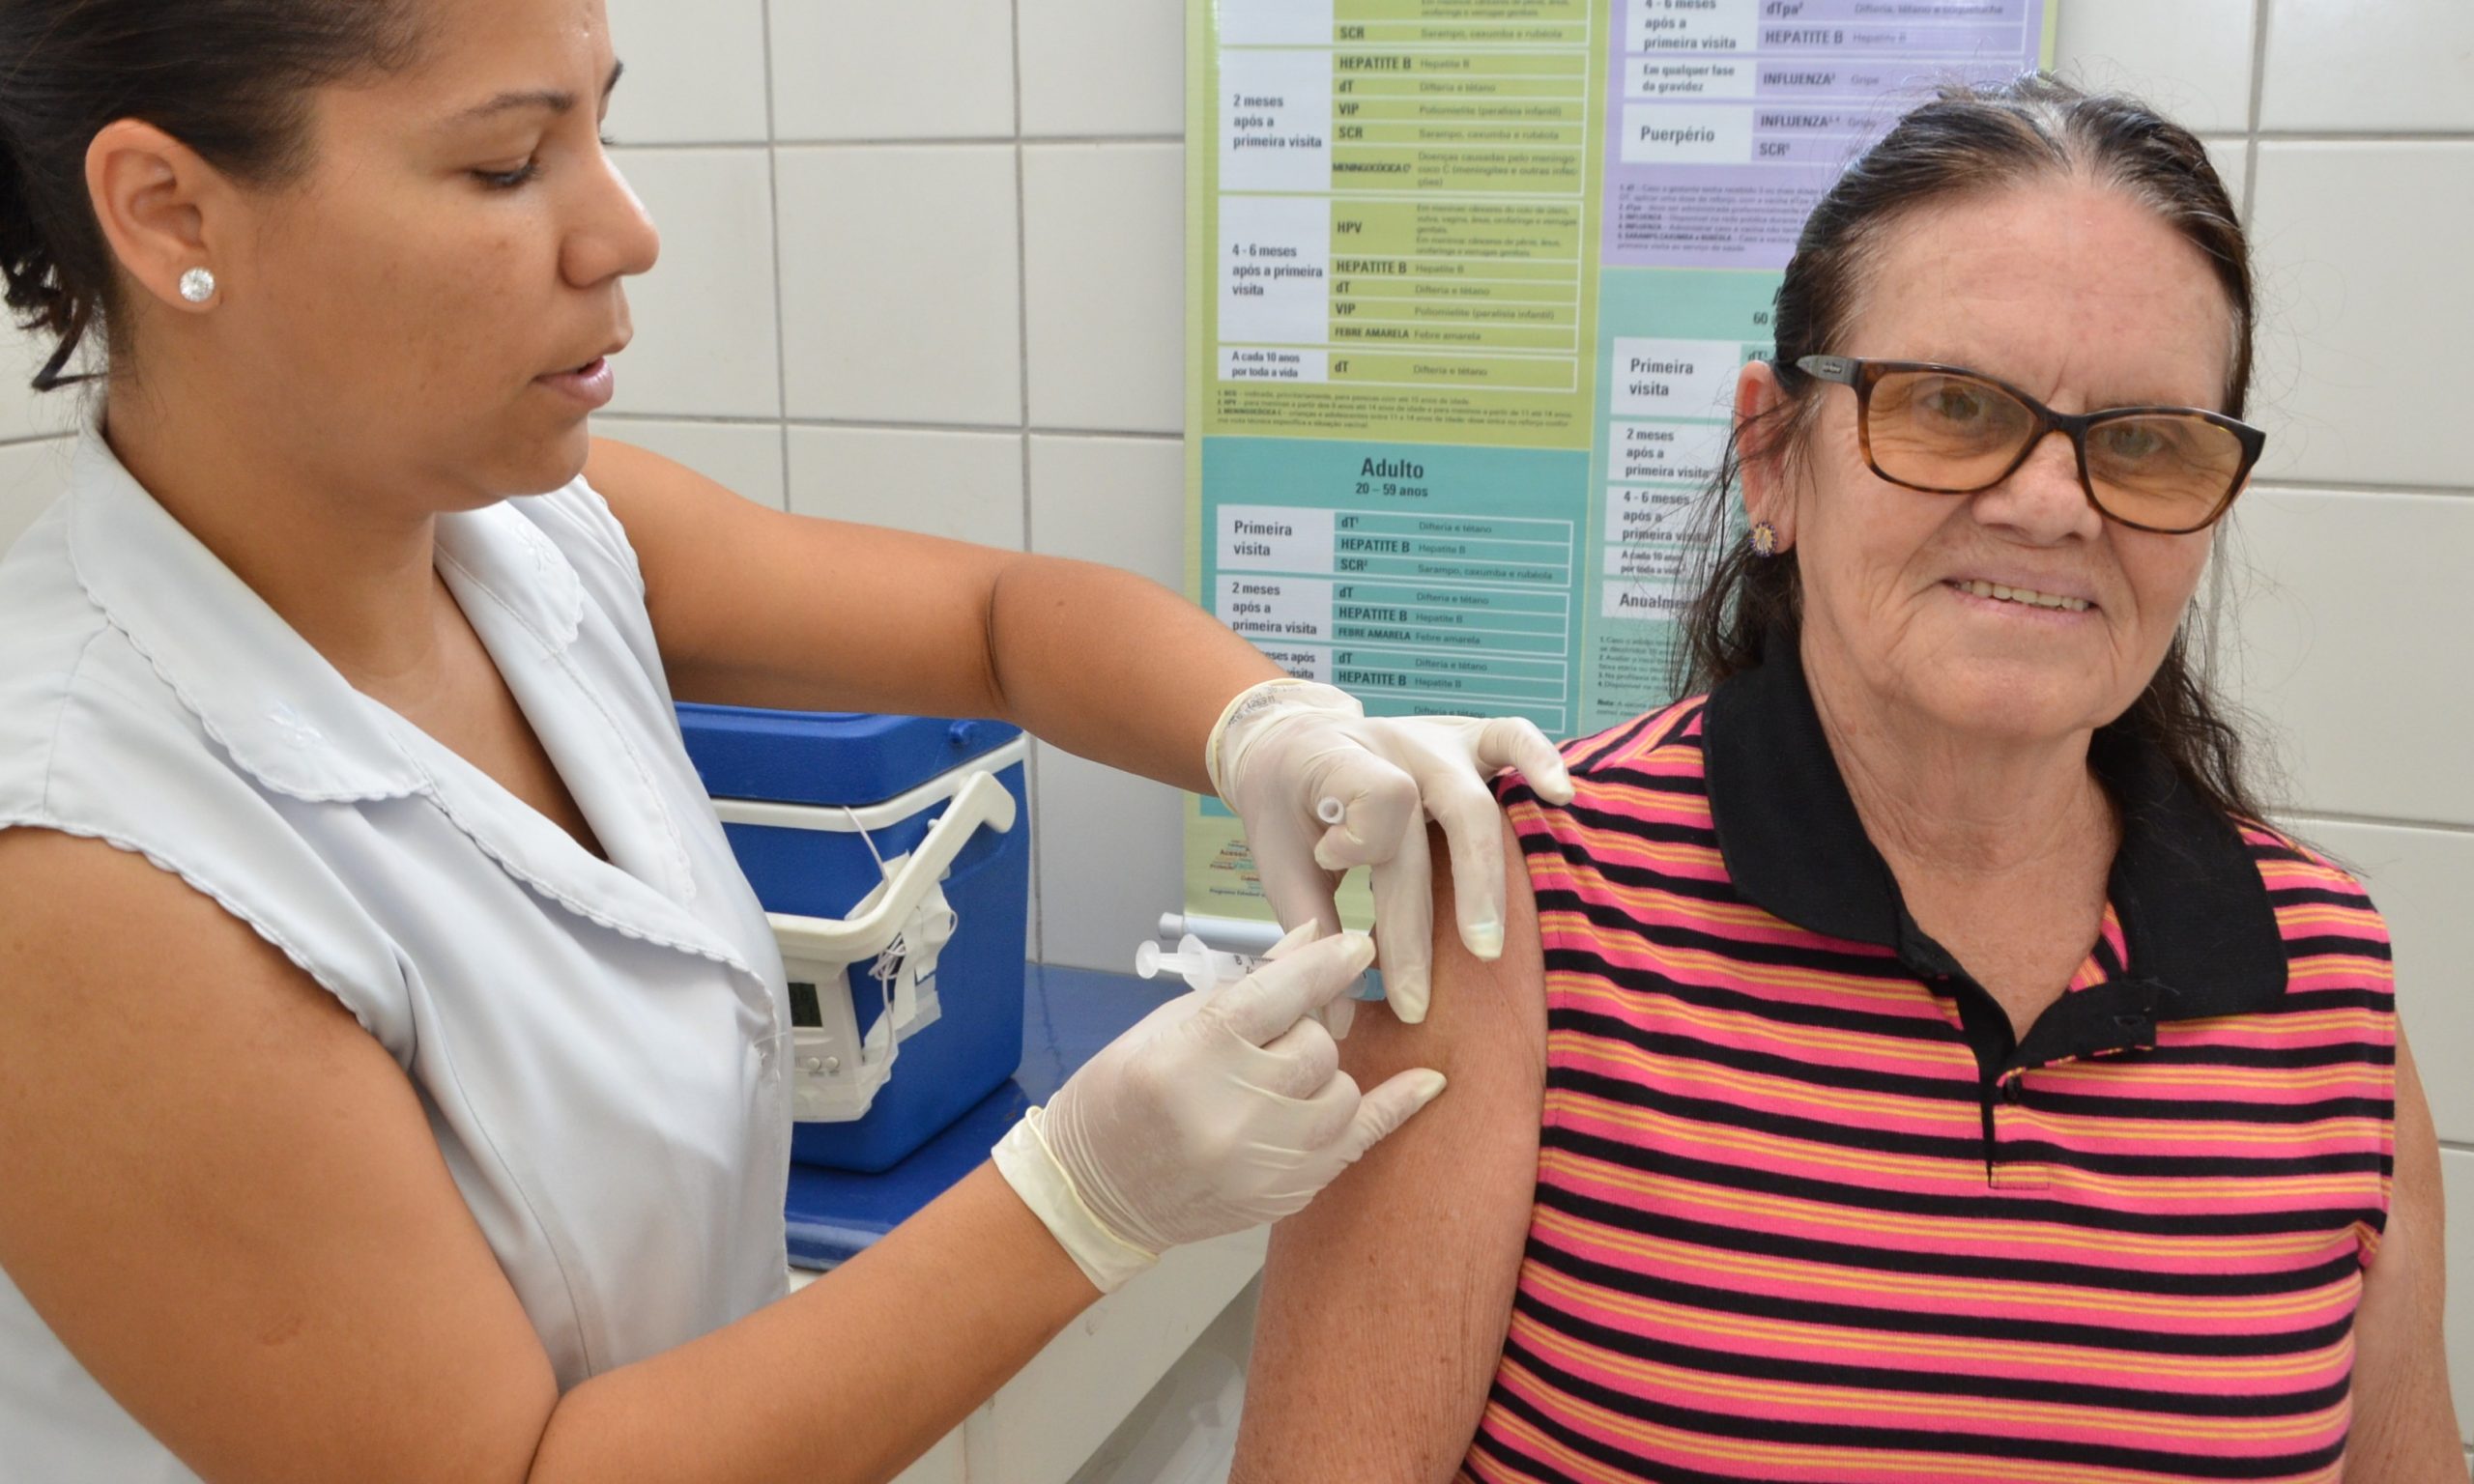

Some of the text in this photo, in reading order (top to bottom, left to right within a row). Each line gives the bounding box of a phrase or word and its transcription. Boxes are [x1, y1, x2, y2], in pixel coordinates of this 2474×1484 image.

[1644, 0, 1653, 9] 4
[1664, 0, 1672, 9] 6
[1675, 0, 1716, 9] meses
[1645, 17, 1686, 31] após a
[1339, 26, 1366, 40] SCR
[1765, 30, 1907, 44] HEPATITE B Hepatite B
[1644, 36, 1737, 52] primeira visita
[1339, 57, 1470, 70] HEPATITE B Hepatite B
[1643, 64, 1735, 77] Em qualquer fase
[1338, 79, 1354, 93] dT
[1851, 73, 1880, 86] Gripe
[1642, 81, 1703, 94] da gravidez
[1233, 94, 1284, 107] 2 meses
[1338, 102, 1360, 116] VIP
[1233, 114, 1275, 131] após a
[1338, 127, 1364, 139] SCR
[1640, 125, 1715, 145] Puerpério
[1233, 134, 1323, 150] primeira visita
[1338, 221, 1363, 234] HPV
[1231, 243, 1240, 256] 4
[1249, 243, 1257, 257] 6
[1258, 245, 1298, 258] meses
[1232, 264, 1323, 280] após a primeira
[1337, 261, 1464, 274] HEPATITE B Hepatite B
[1231, 282, 1265, 297] visita
[1336, 281, 1351, 294] dT
[1415, 284, 1450, 295] Difteria
[1460, 286, 1490, 296] tétano
[1336, 302, 1555, 321] VIP Poliomielite (paralisia infantil)
[1753, 311, 1769, 325] 60
[1335, 328, 1482, 341] FEBRE AMARELA Febre amarela
[1231, 351, 1300, 363] A cada 10 anos
[1231, 366, 1299, 379] por toda a vida
[1335, 360, 1349, 374] dT
[1413, 364, 1448, 375] Difteria
[1457, 366, 1488, 376] tétano
[1630, 357, 1694, 375] Primeira
[1628, 381, 1670, 397] visita
[1626, 428, 1675, 442] 2 meses
[1625, 446, 1664, 461] após a
[1361, 457, 1424, 479] Adulto
[1625, 466, 1675, 478] primeira
[1355, 482, 1369, 495] 20
[1383, 483, 1396, 496] 59
[1399, 485, 1428, 498] anos
[1624, 491, 1631, 503] 4
[1641, 491, 1650, 503] 6
[1652, 493, 1690, 505] meses
[1623, 510, 1662, 524] após a
[1234, 520, 1293, 537] Primeira
[1419, 522, 1453, 532] Difteria
[1462, 524, 1492, 534] tétano
[1622, 528, 1673, 542] primeira
[1233, 541, 1271, 557] visita
[1341, 538, 1466, 555] HEPATITE B Hepatite B
[1621, 550, 1629, 559] A
[1629, 551, 1652, 560] cada
[1654, 552, 1663, 560] 10
[1418, 564, 1462, 577] Sarampo,
[1464, 568, 1507, 578] caxumba
[1516, 570, 1553, 581] rubéola
[1620, 565, 1635, 575] por
[1636, 564, 1655, 574] toda
[1231, 582, 1280, 596] 2 meses
[1339, 586, 1354, 599] dT
[1417, 591, 1450, 603] Difteria
[1460, 594, 1489, 605] tétano
[1232, 601, 1272, 614] após a
[1338, 607, 1462, 624] HEPATITE B Hepatite B
[1232, 618, 1317, 635] primeira visita
[1338, 627, 1481, 644] FEBRE AMARELA Febre amarela
[1262, 650, 1316, 665] eses após
[1338, 652, 1353, 665] dT
[1415, 658, 1449, 669] Difteria
[1458, 660, 1487, 671] tétano
[1338, 671, 1462, 688] HEPATITE B Hepatite B
[1414, 705, 1448, 717] Difteria
[1457, 708, 1486, 718] tétano
